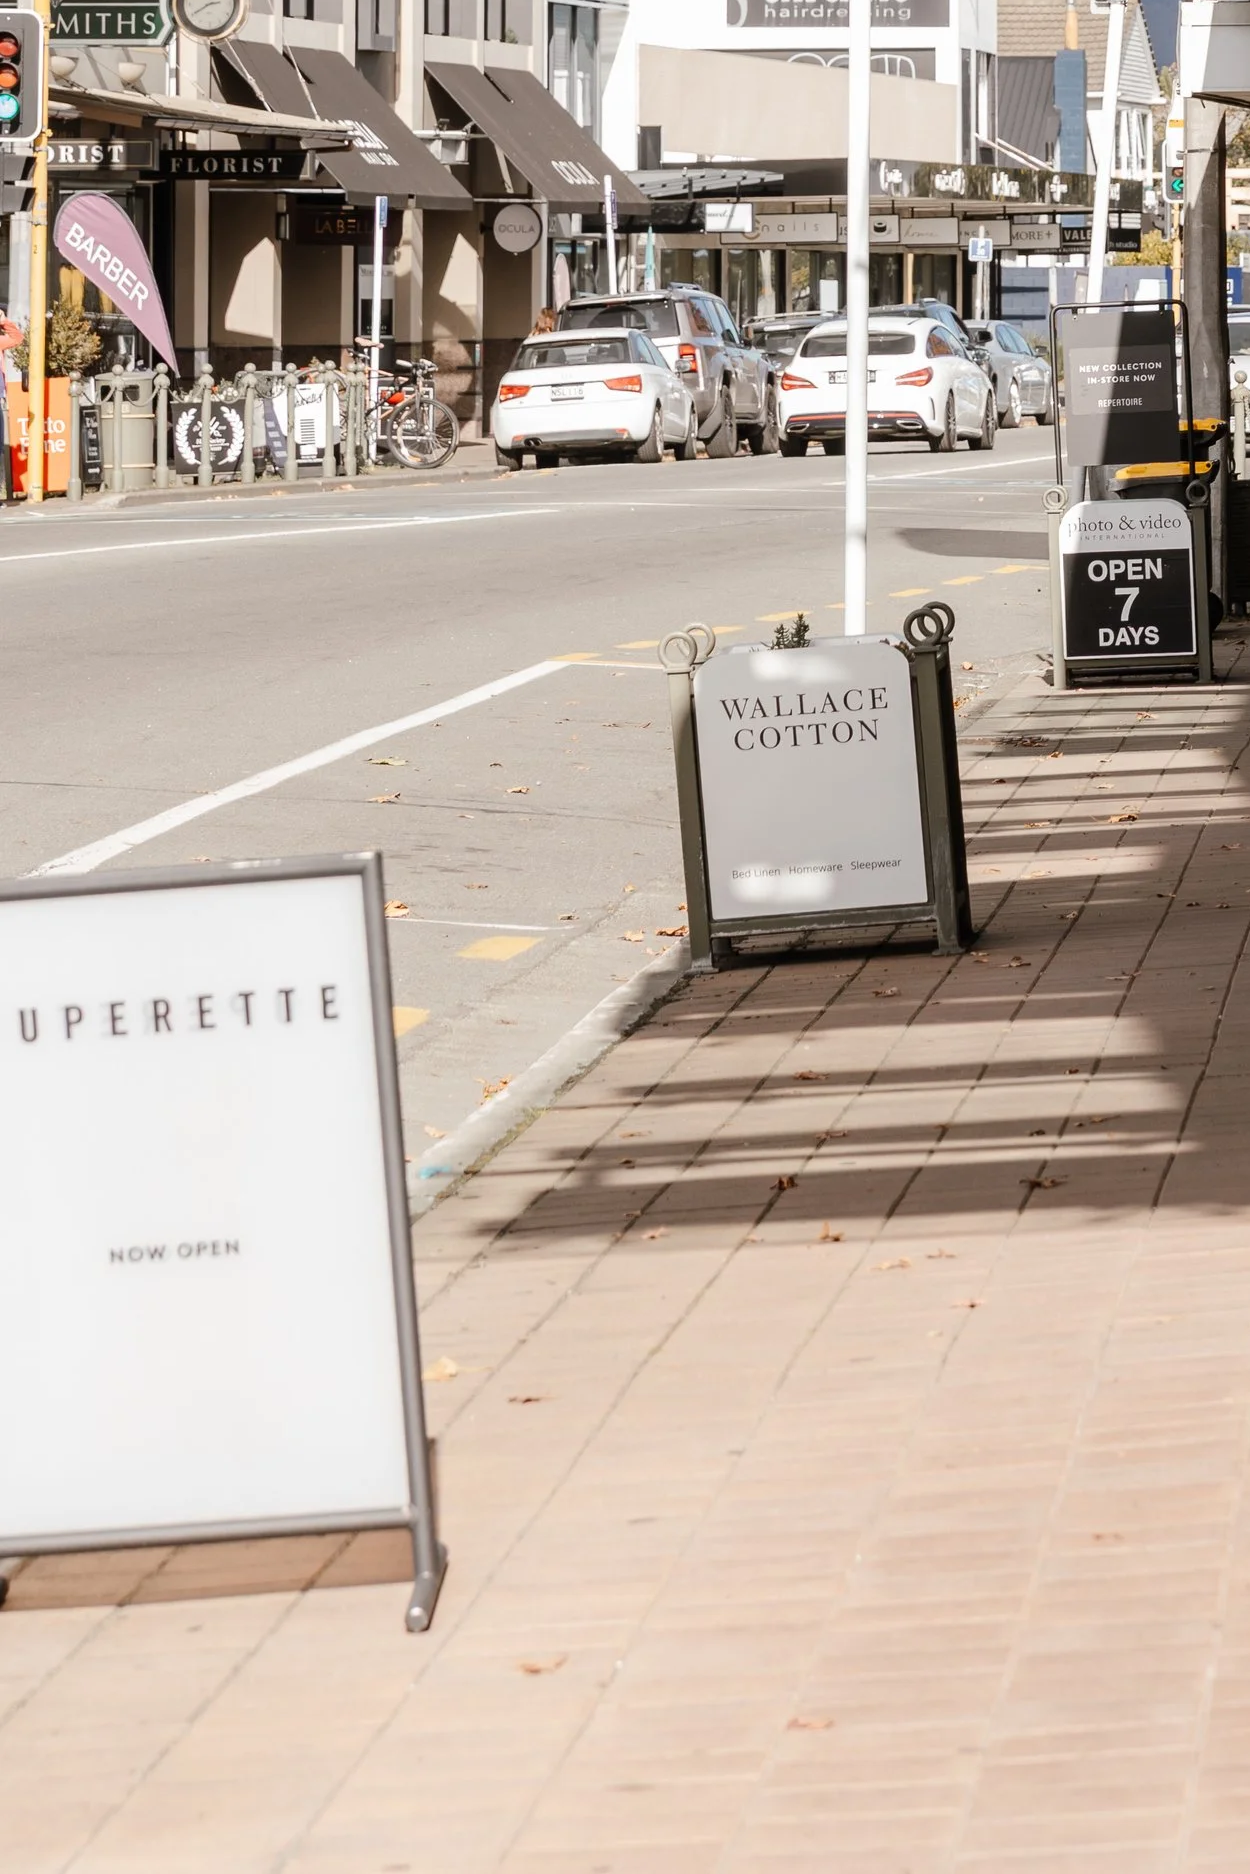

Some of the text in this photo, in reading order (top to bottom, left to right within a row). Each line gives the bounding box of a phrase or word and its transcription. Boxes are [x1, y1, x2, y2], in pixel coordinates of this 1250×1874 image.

[56, 12, 157, 35] MITHS
[763, 4, 912, 21] hairdreing
[171, 157, 283, 174] FLORIST
[497, 223, 536, 235] OCULA
[1064, 229, 1092, 242] VALE
[65, 222, 150, 311] BARBER
[1079, 362, 1162, 373] NEW COLLECTION
[1087, 374, 1156, 385] IN-STORE NOW
[1098, 397, 1143, 408] REPERTOIRE
[1068, 513, 1182, 538] photo & video
[1079, 532, 1166, 542] INTERNATIONAL
[1087, 557, 1164, 582] OPEN
[1114, 586, 1140, 622] 7
[1098, 625, 1160, 648] DAYS
[719, 687, 889, 722] WALLACE
[734, 719, 880, 752] COTTON
[732, 858, 902, 880] Bed Linen Homeware Sleepwear
[18, 983, 342, 1045] UPERETTE
[108, 1237, 242, 1265] NOW OPEN
